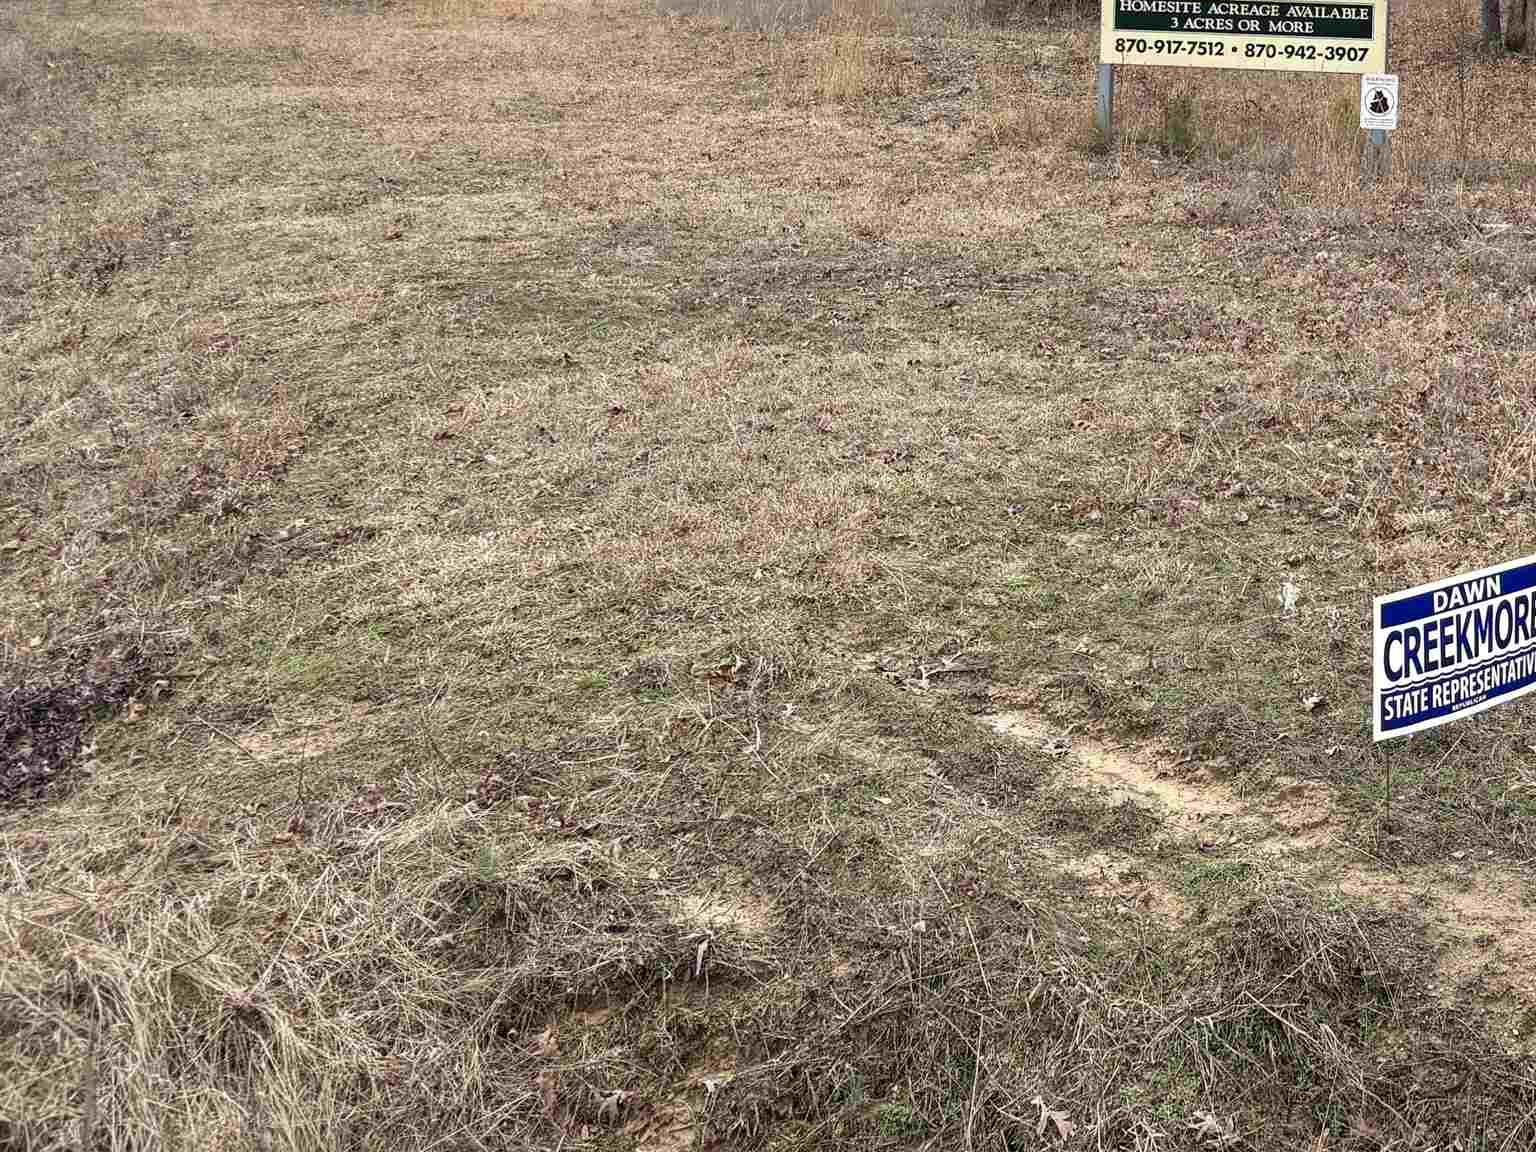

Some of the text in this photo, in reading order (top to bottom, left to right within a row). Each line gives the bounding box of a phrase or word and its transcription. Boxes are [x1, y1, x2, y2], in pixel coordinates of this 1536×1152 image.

[1120, 0, 1369, 20] HOMESITE ACREAGE AVAILABLE
[1170, 17, 1314, 34] 3 ACRES OR MORE
[1115, 38, 1369, 62] 870-917-7512 870-942-3907
[1433, 575, 1501, 613] DAWN
[1384, 686, 1429, 720] STATE
